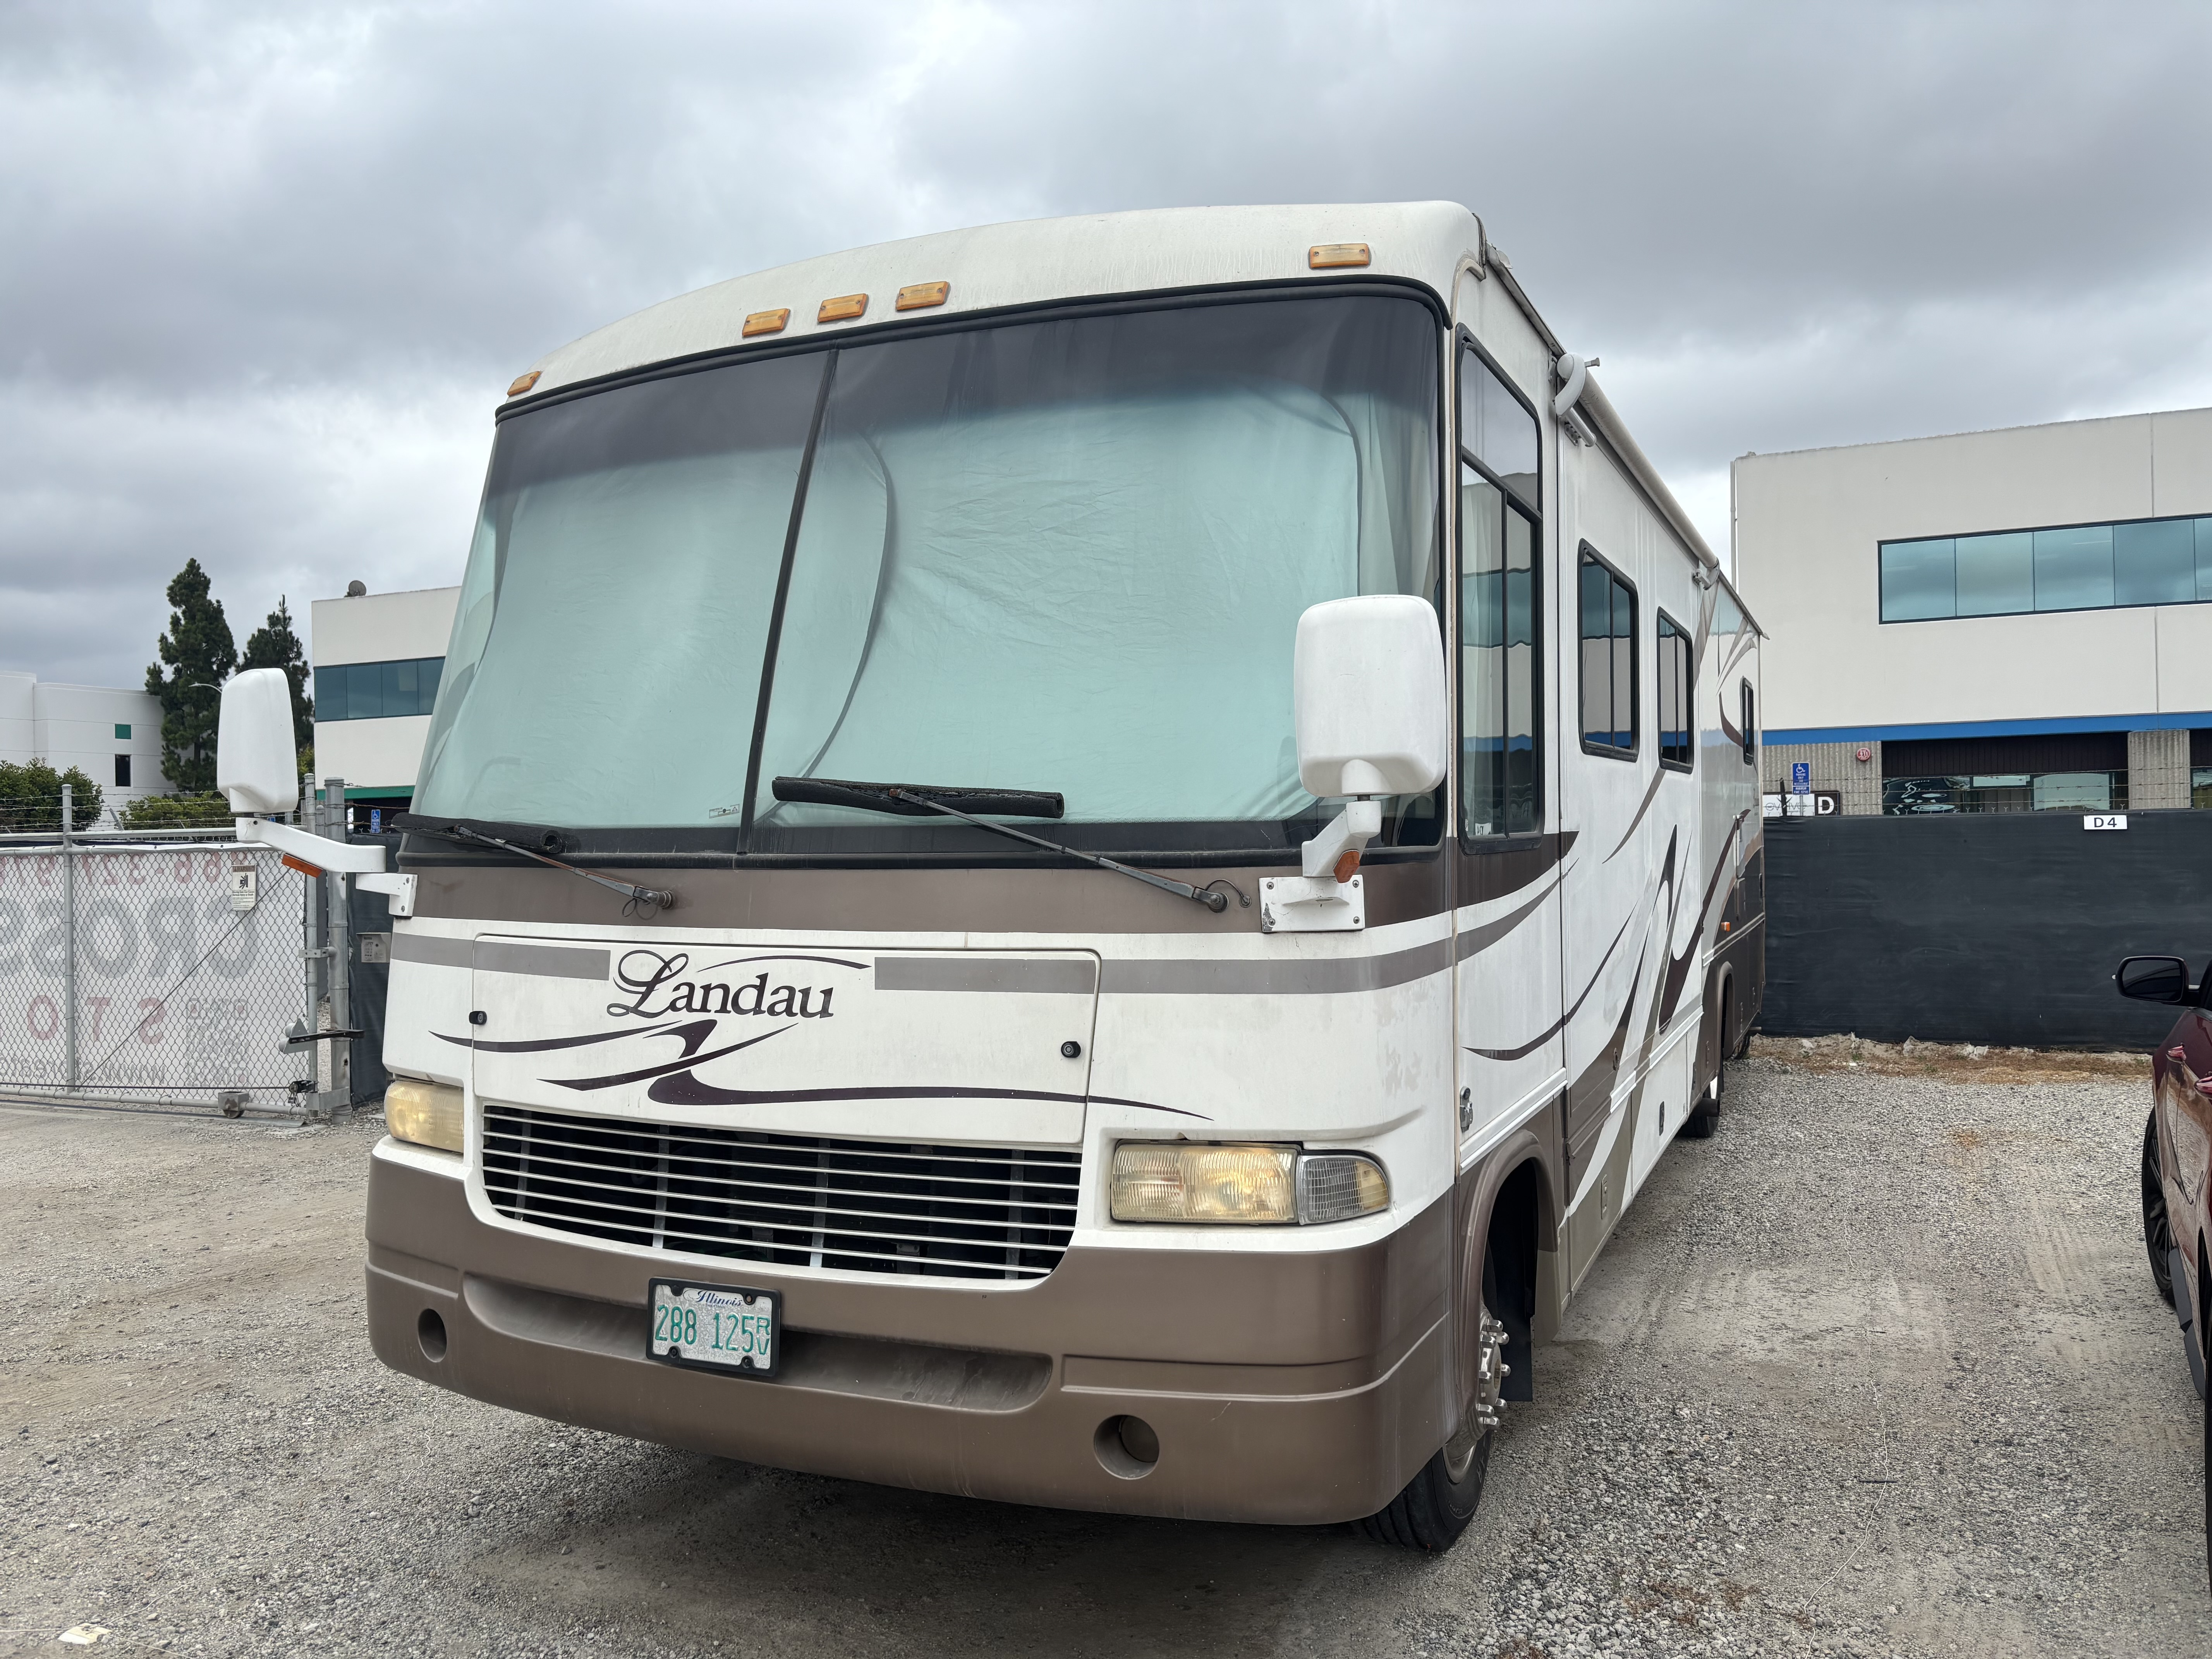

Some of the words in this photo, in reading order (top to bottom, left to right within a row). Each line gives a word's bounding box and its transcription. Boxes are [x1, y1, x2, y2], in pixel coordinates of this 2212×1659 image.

[1818, 797, 1834, 814] D
[607, 950, 833, 1018] Landau
[683, 1290, 742, 1307] Illinois
[655, 1304, 697, 1345] 288
[711, 1312, 754, 1353] 125
